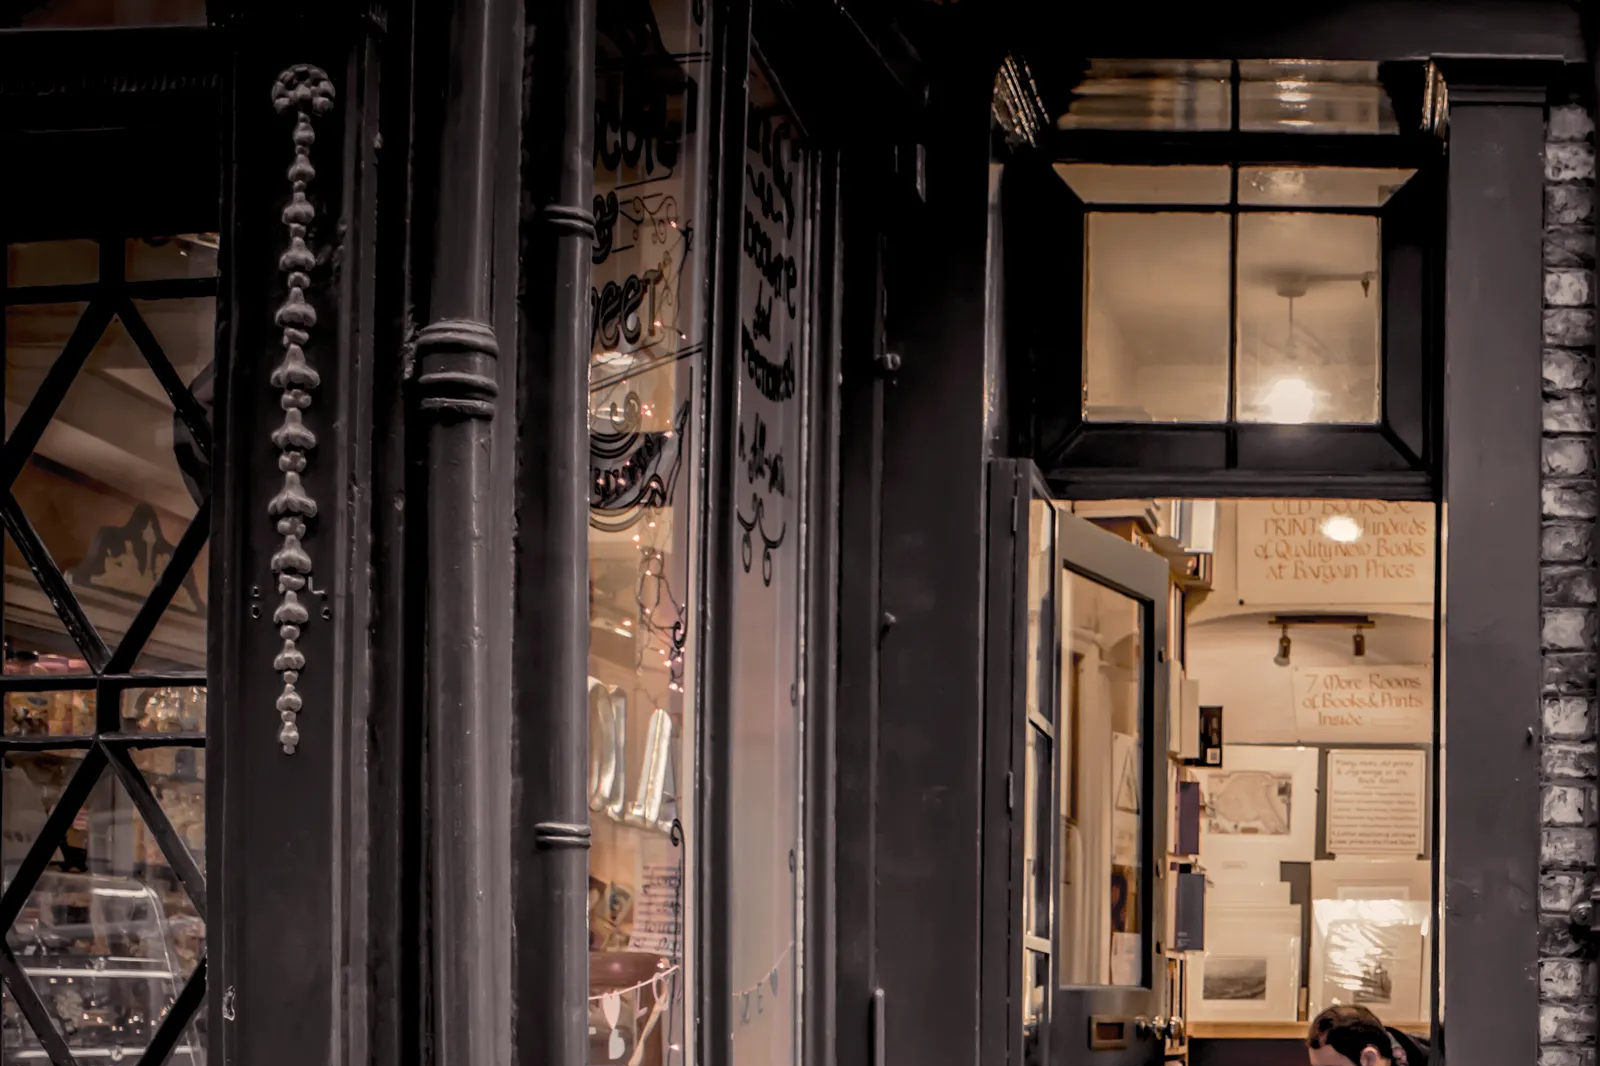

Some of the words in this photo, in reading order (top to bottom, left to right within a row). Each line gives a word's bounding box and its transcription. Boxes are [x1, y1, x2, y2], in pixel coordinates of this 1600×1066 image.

[1263, 517, 1318, 537] PRINT
[1364, 517, 1428, 537] undreds
[1275, 538, 1333, 563] Quality
[1376, 537, 1427, 558] Books
[1293, 560, 1359, 584] Bargain
[1365, 559, 1416, 579] Prices
[1304, 673, 1319, 694] 7
[1323, 673, 1362, 691] More
[1369, 672, 1421, 690] Rooms
[1381, 691, 1423, 709] Prints
[1318, 711, 1364, 727] Inside
